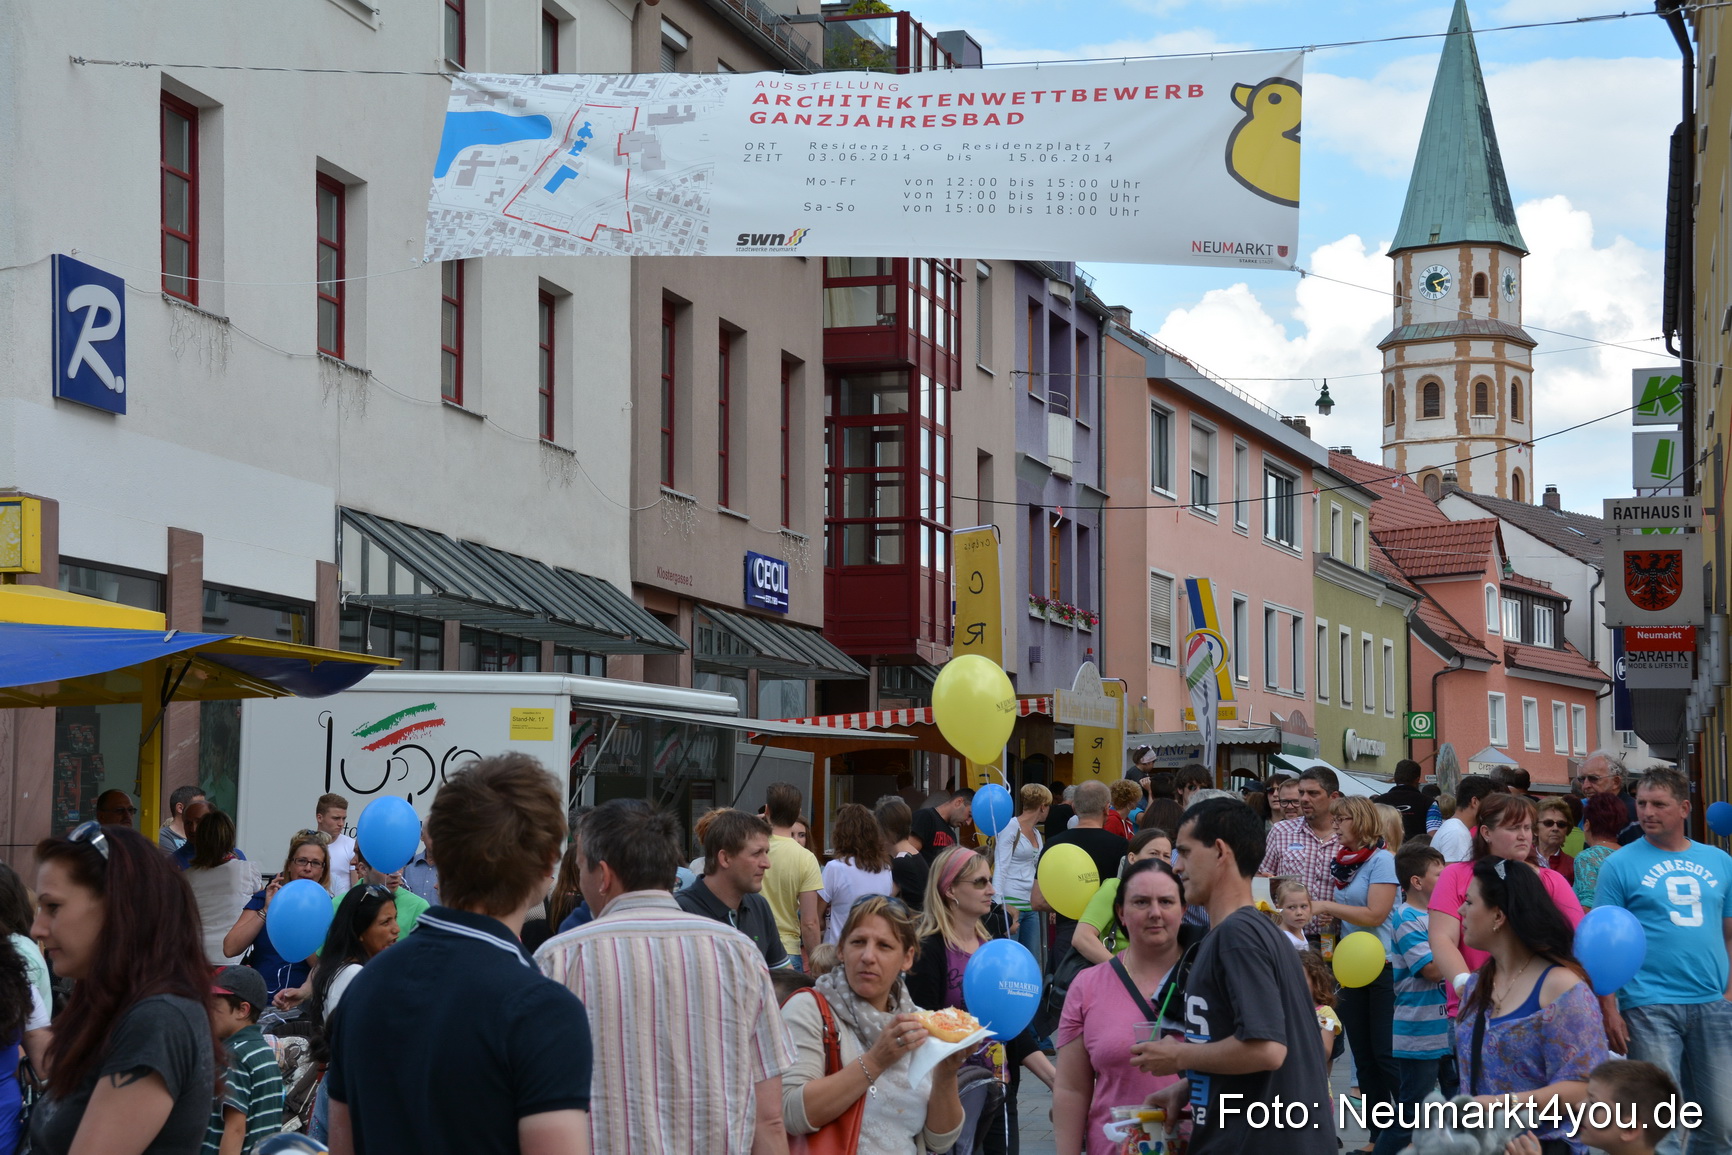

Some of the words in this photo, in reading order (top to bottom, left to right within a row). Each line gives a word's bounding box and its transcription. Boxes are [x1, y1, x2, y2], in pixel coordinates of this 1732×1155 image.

[755, 80, 899, 92] AUSSTELLUNG
[752, 83, 1205, 109] ARCHITEKTENWETTBEWERB
[749, 111, 1025, 129] GANZJAHRESBAD
[744, 142, 777, 151] ORT
[809, 141, 889, 151] Residenz
[902, 143, 942, 151] 1.OG
[962, 141, 1091, 152] Residenzplatz
[1103, 142, 1111, 150] 7
[743, 153, 783, 163] ZEIT
[808, 152, 911, 162] 03.06.2014
[947, 153, 972, 162] bis
[1008, 153, 1113, 163] 15.06.2014
[806, 177, 856, 187] Mo-Fr
[904, 178, 934, 187] von
[947, 177, 997, 187] 12:00
[1009, 178, 1035, 187] bis
[1047, 178, 1098, 188] 15:00
[1110, 179, 1141, 189] Uhr
[903, 191, 933, 200] von
[946, 190, 996, 200] 17:00
[1008, 190, 1034, 201] bis
[1046, 191, 1098, 202] 19:00
[1110, 192, 1140, 203] Uhr
[803, 202, 855, 212] Sa-So
[902, 204, 932, 213] von
[945, 203, 996, 214] 15:00
[1008, 204, 1033, 215] bis
[1046, 205, 1097, 216] 18:00
[1109, 207, 1140, 217] Uhr
[736, 233, 785, 246] swn
[1192, 240, 1274, 256] NEUMARKT
[1613, 505, 1681, 520] RATHAUS
[1683, 505, 1692, 519] II
[656, 565, 689, 586] Klostergasse
[755, 557, 788, 595] CECIL
[1636, 631, 1683, 640] Neumarkt
[1627, 651, 1674, 662] SARAH
[1677, 651, 1689, 662] K
[1641, 859, 1719, 889] MINNESOTA
[1665, 875, 1704, 927] 9
